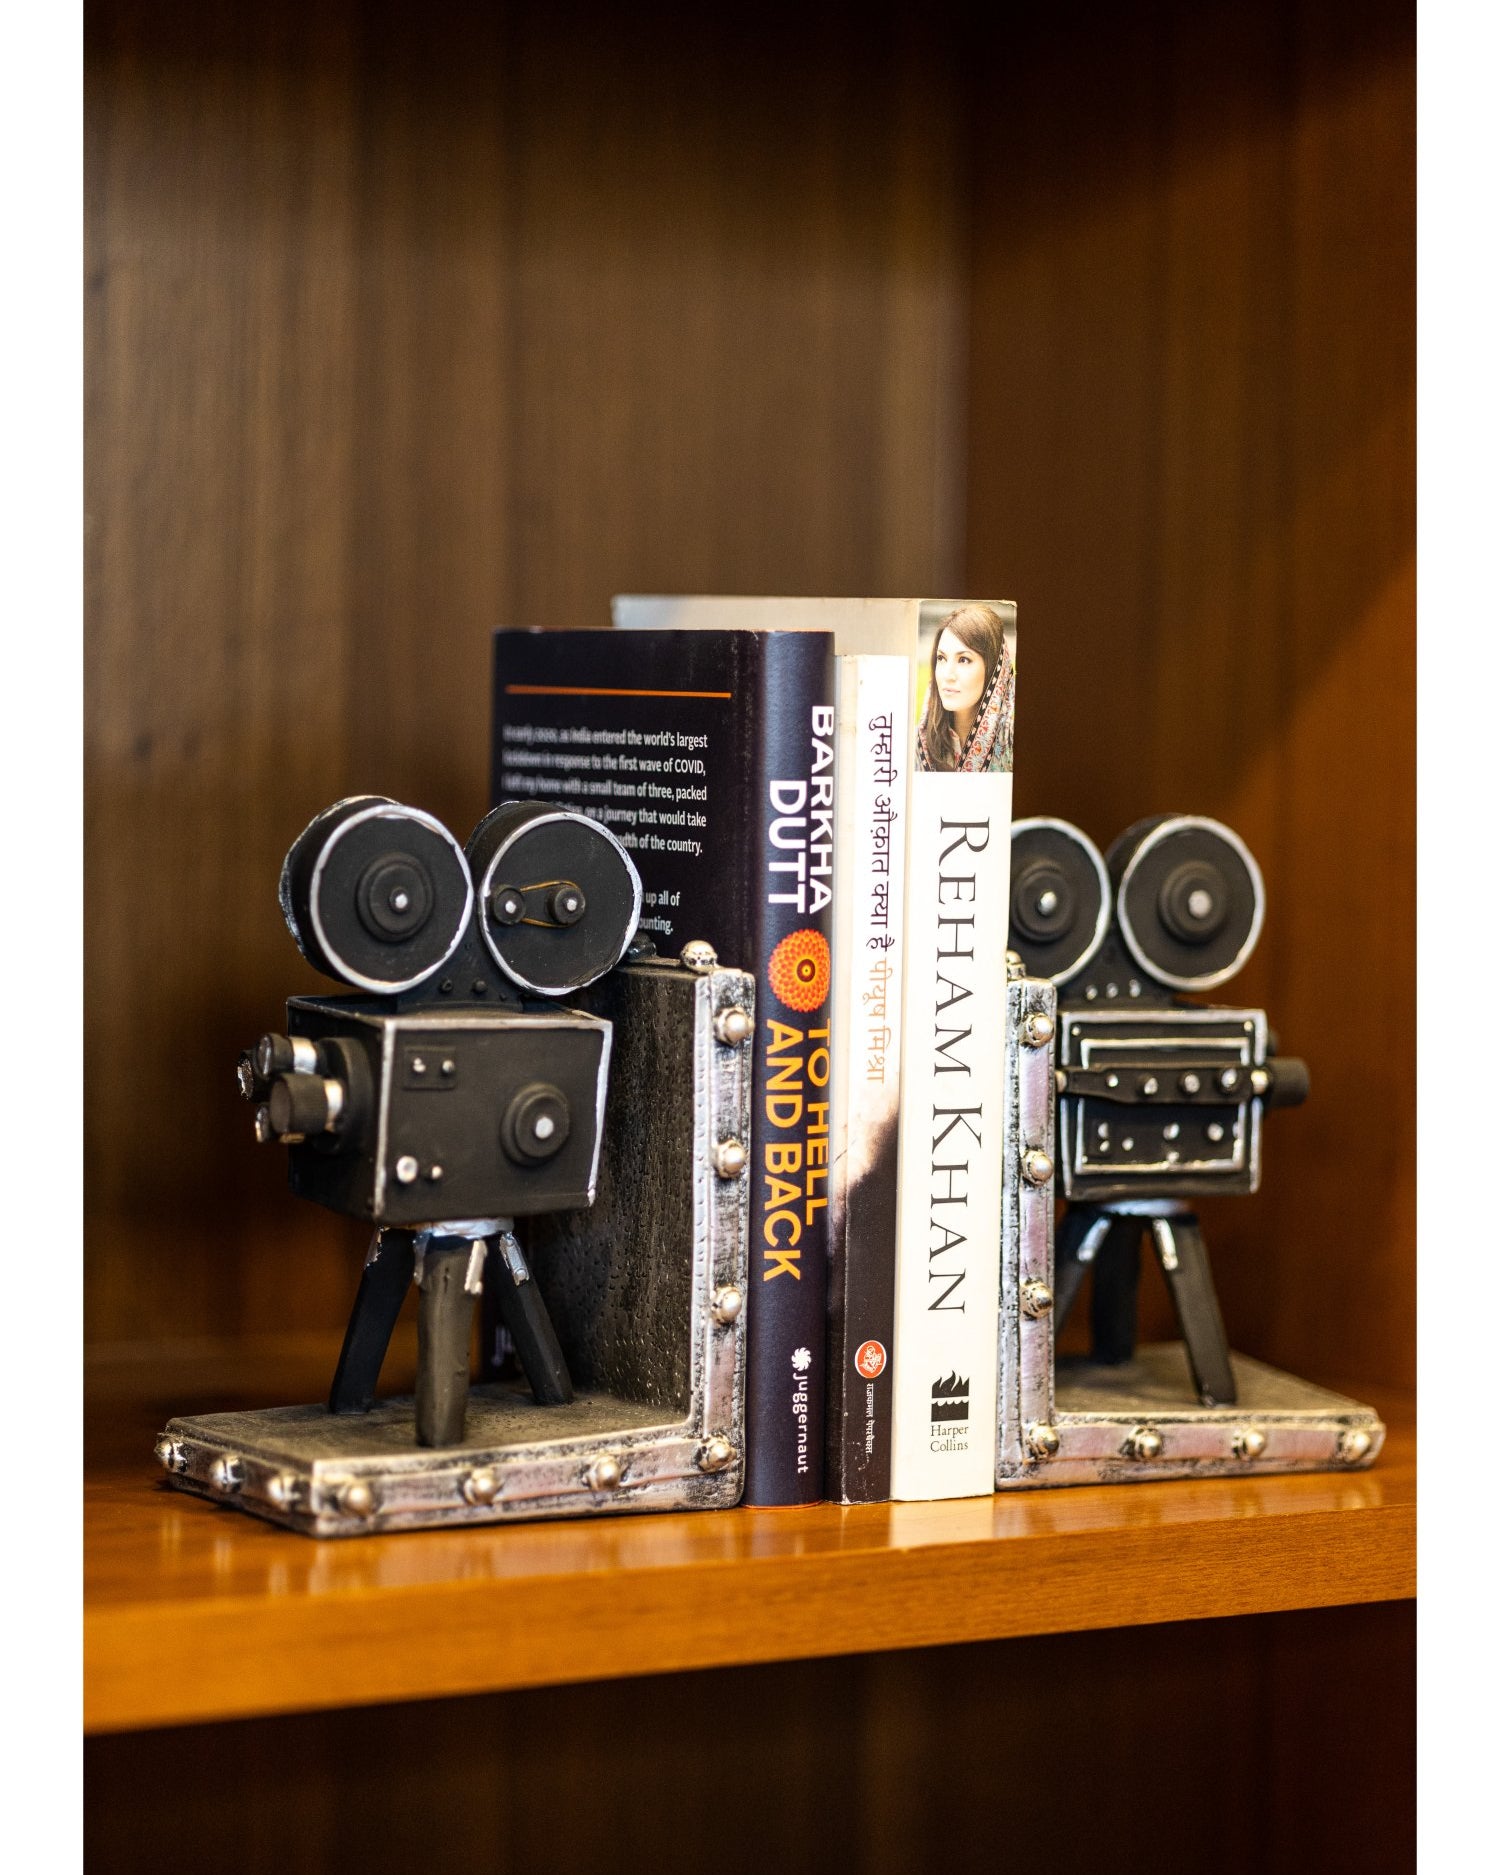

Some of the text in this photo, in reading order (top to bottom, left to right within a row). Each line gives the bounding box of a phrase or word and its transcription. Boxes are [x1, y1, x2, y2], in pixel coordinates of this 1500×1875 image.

[592, 729, 626, 745] entered
[627, 729, 642, 746] the
[643, 731, 676, 746] world's
[676, 731, 708, 751] largest
[868, 712, 898, 787] तुम्हारी
[591, 754, 602, 770] to
[602, 754, 618, 770] the
[619, 754, 638, 771] first
[639, 758, 662, 772] wave
[663, 757, 673, 773] of
[674, 758, 706, 776] COVID,
[589, 779, 612, 796] small
[613, 781, 636, 797] team
[636, 781, 648, 797] of
[648, 782, 675, 801] three,
[675, 785, 707, 802] packed
[603, 805, 637, 826] journey
[638, 808, 657, 824] that
[659, 810, 686, 826] would
[687, 812, 707, 827] take
[808, 706, 834, 915] BARKHA
[639, 834, 650, 849] of
[651, 835, 666, 850] the
[666, 838, 703, 856] country.
[768, 780, 807, 914] DUTT
[645, 890, 681, 907] up all of
[870, 881, 889, 928] क्या
[866, 934, 895, 952] है
[863, 957, 893, 1084] पीयूष मिश्रा
[928, 816, 990, 1314] REHAM KHAN
[805, 1018, 831, 1226] TO HELL
[763, 1019, 803, 1282] AND BACK
[931, 1425, 969, 1438] Harper
[930, 1438, 969, 1453] Collins
